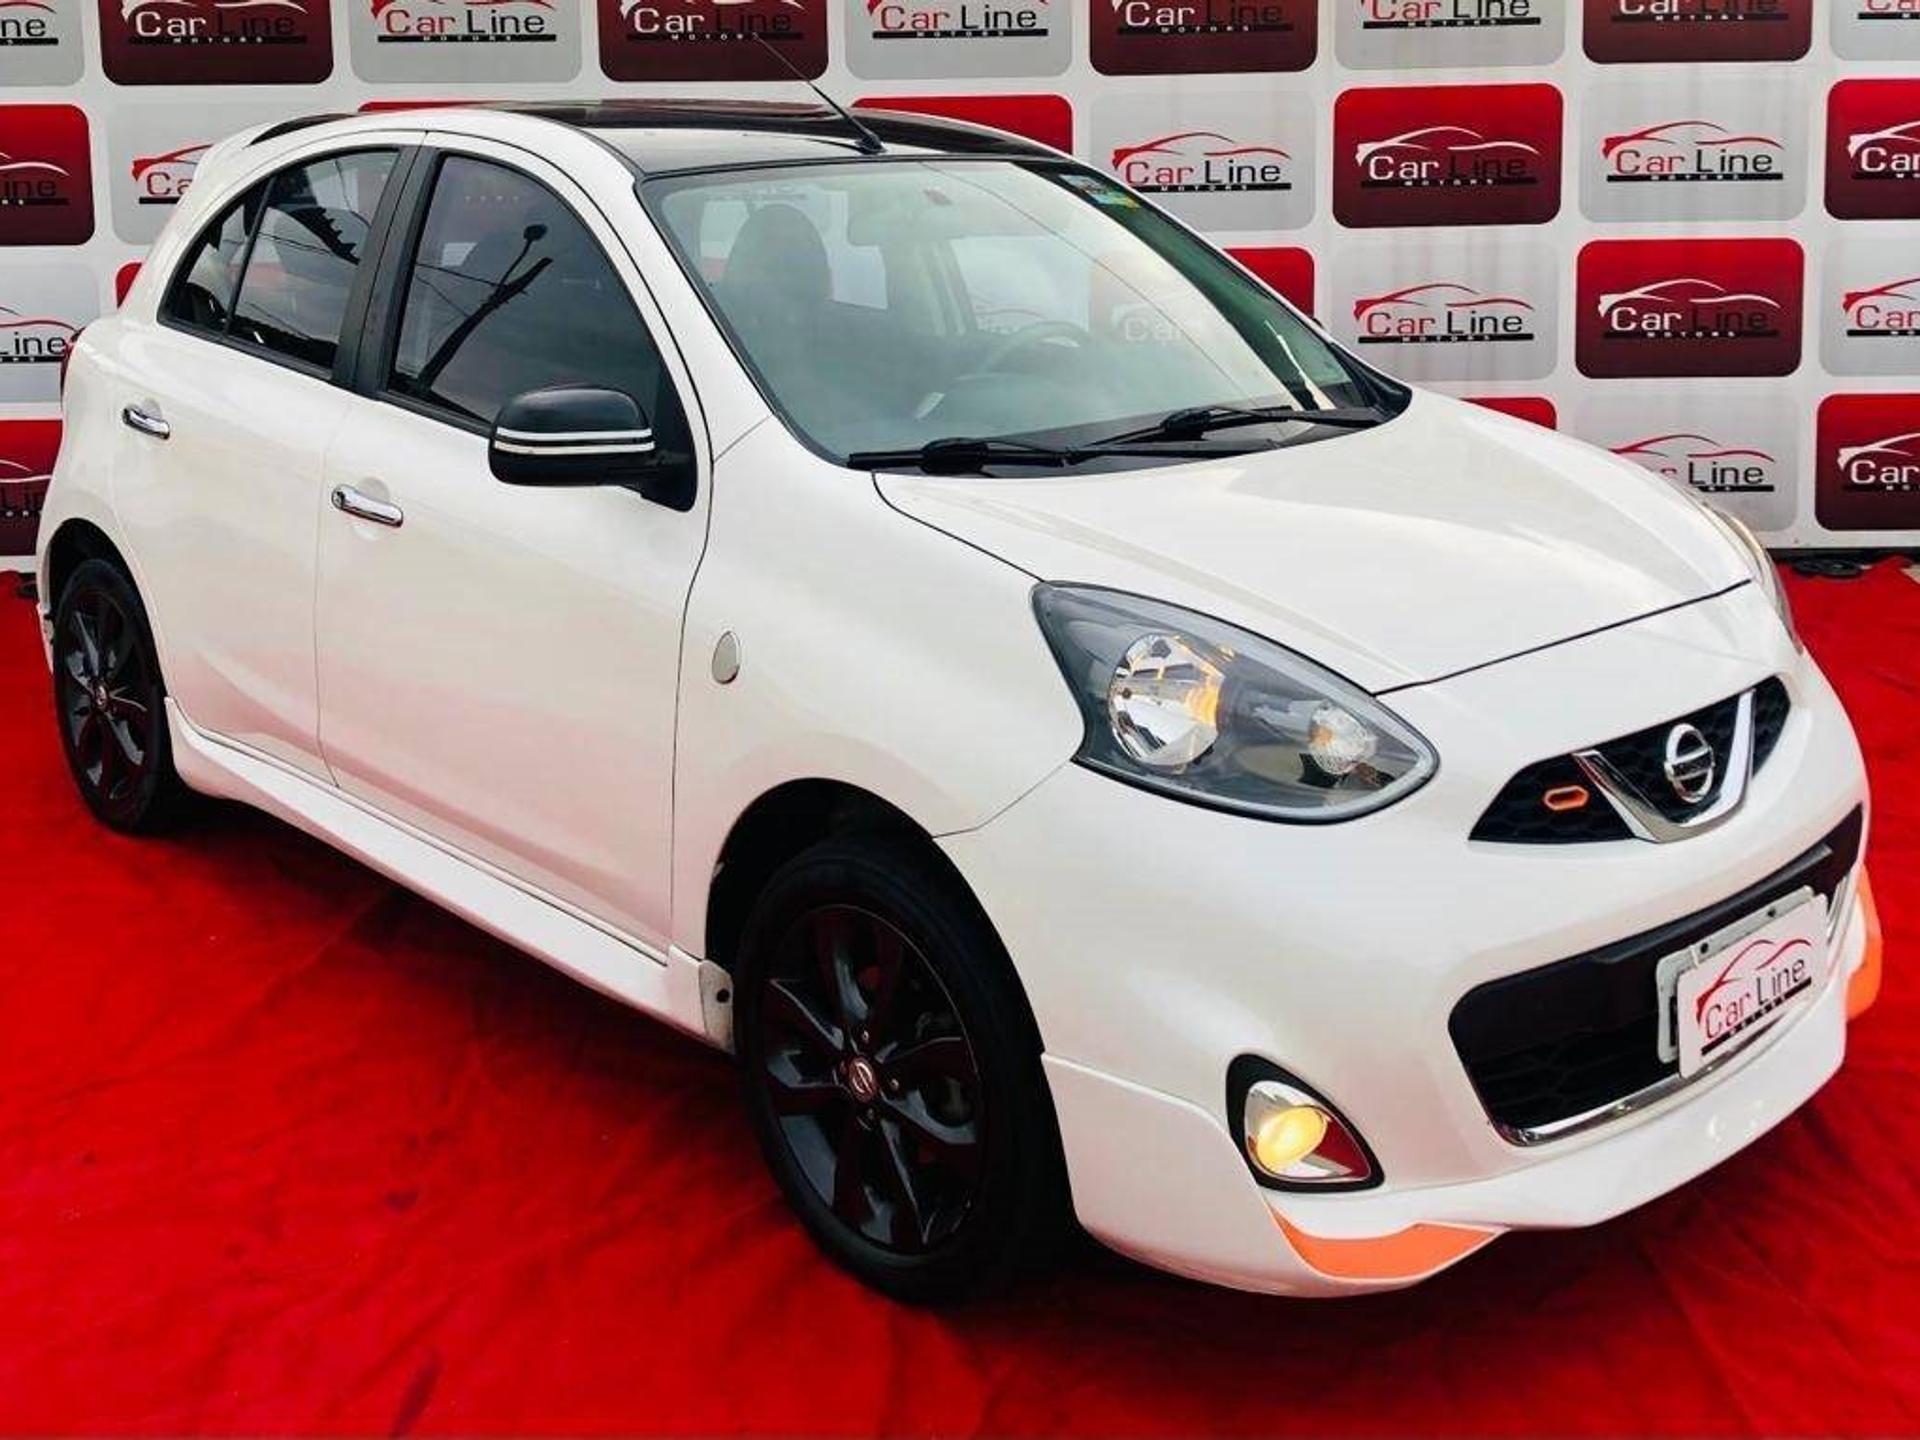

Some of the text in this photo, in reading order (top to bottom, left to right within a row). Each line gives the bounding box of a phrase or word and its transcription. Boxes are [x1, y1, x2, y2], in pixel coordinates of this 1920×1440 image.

[385, 9, 545, 33] Car Line
[634, 8, 792, 33] Car Line
[880, 5, 1037, 30] Car Line
[1125, 2, 1195, 27] Car
[1370, 0, 1530, 20] Car Line
[135, 11, 295, 37] Car Line
[1126, 157, 1281, 184] Car Line
[1369, 154, 1527, 179] Car Line
[1615, 148, 1772, 174] Car Line
[147, 171, 193, 195] Ca
[1367, 308, 1523, 335] Car Line
[1611, 306, 1767, 331] Car Line
[1857, 305, 1920, 328] Car
[1688, 461, 1764, 485] Line
[1851, 460, 1920, 484] Car
[1705, 991, 1752, 1039] Car
[1756, 958, 1806, 1006] Line
